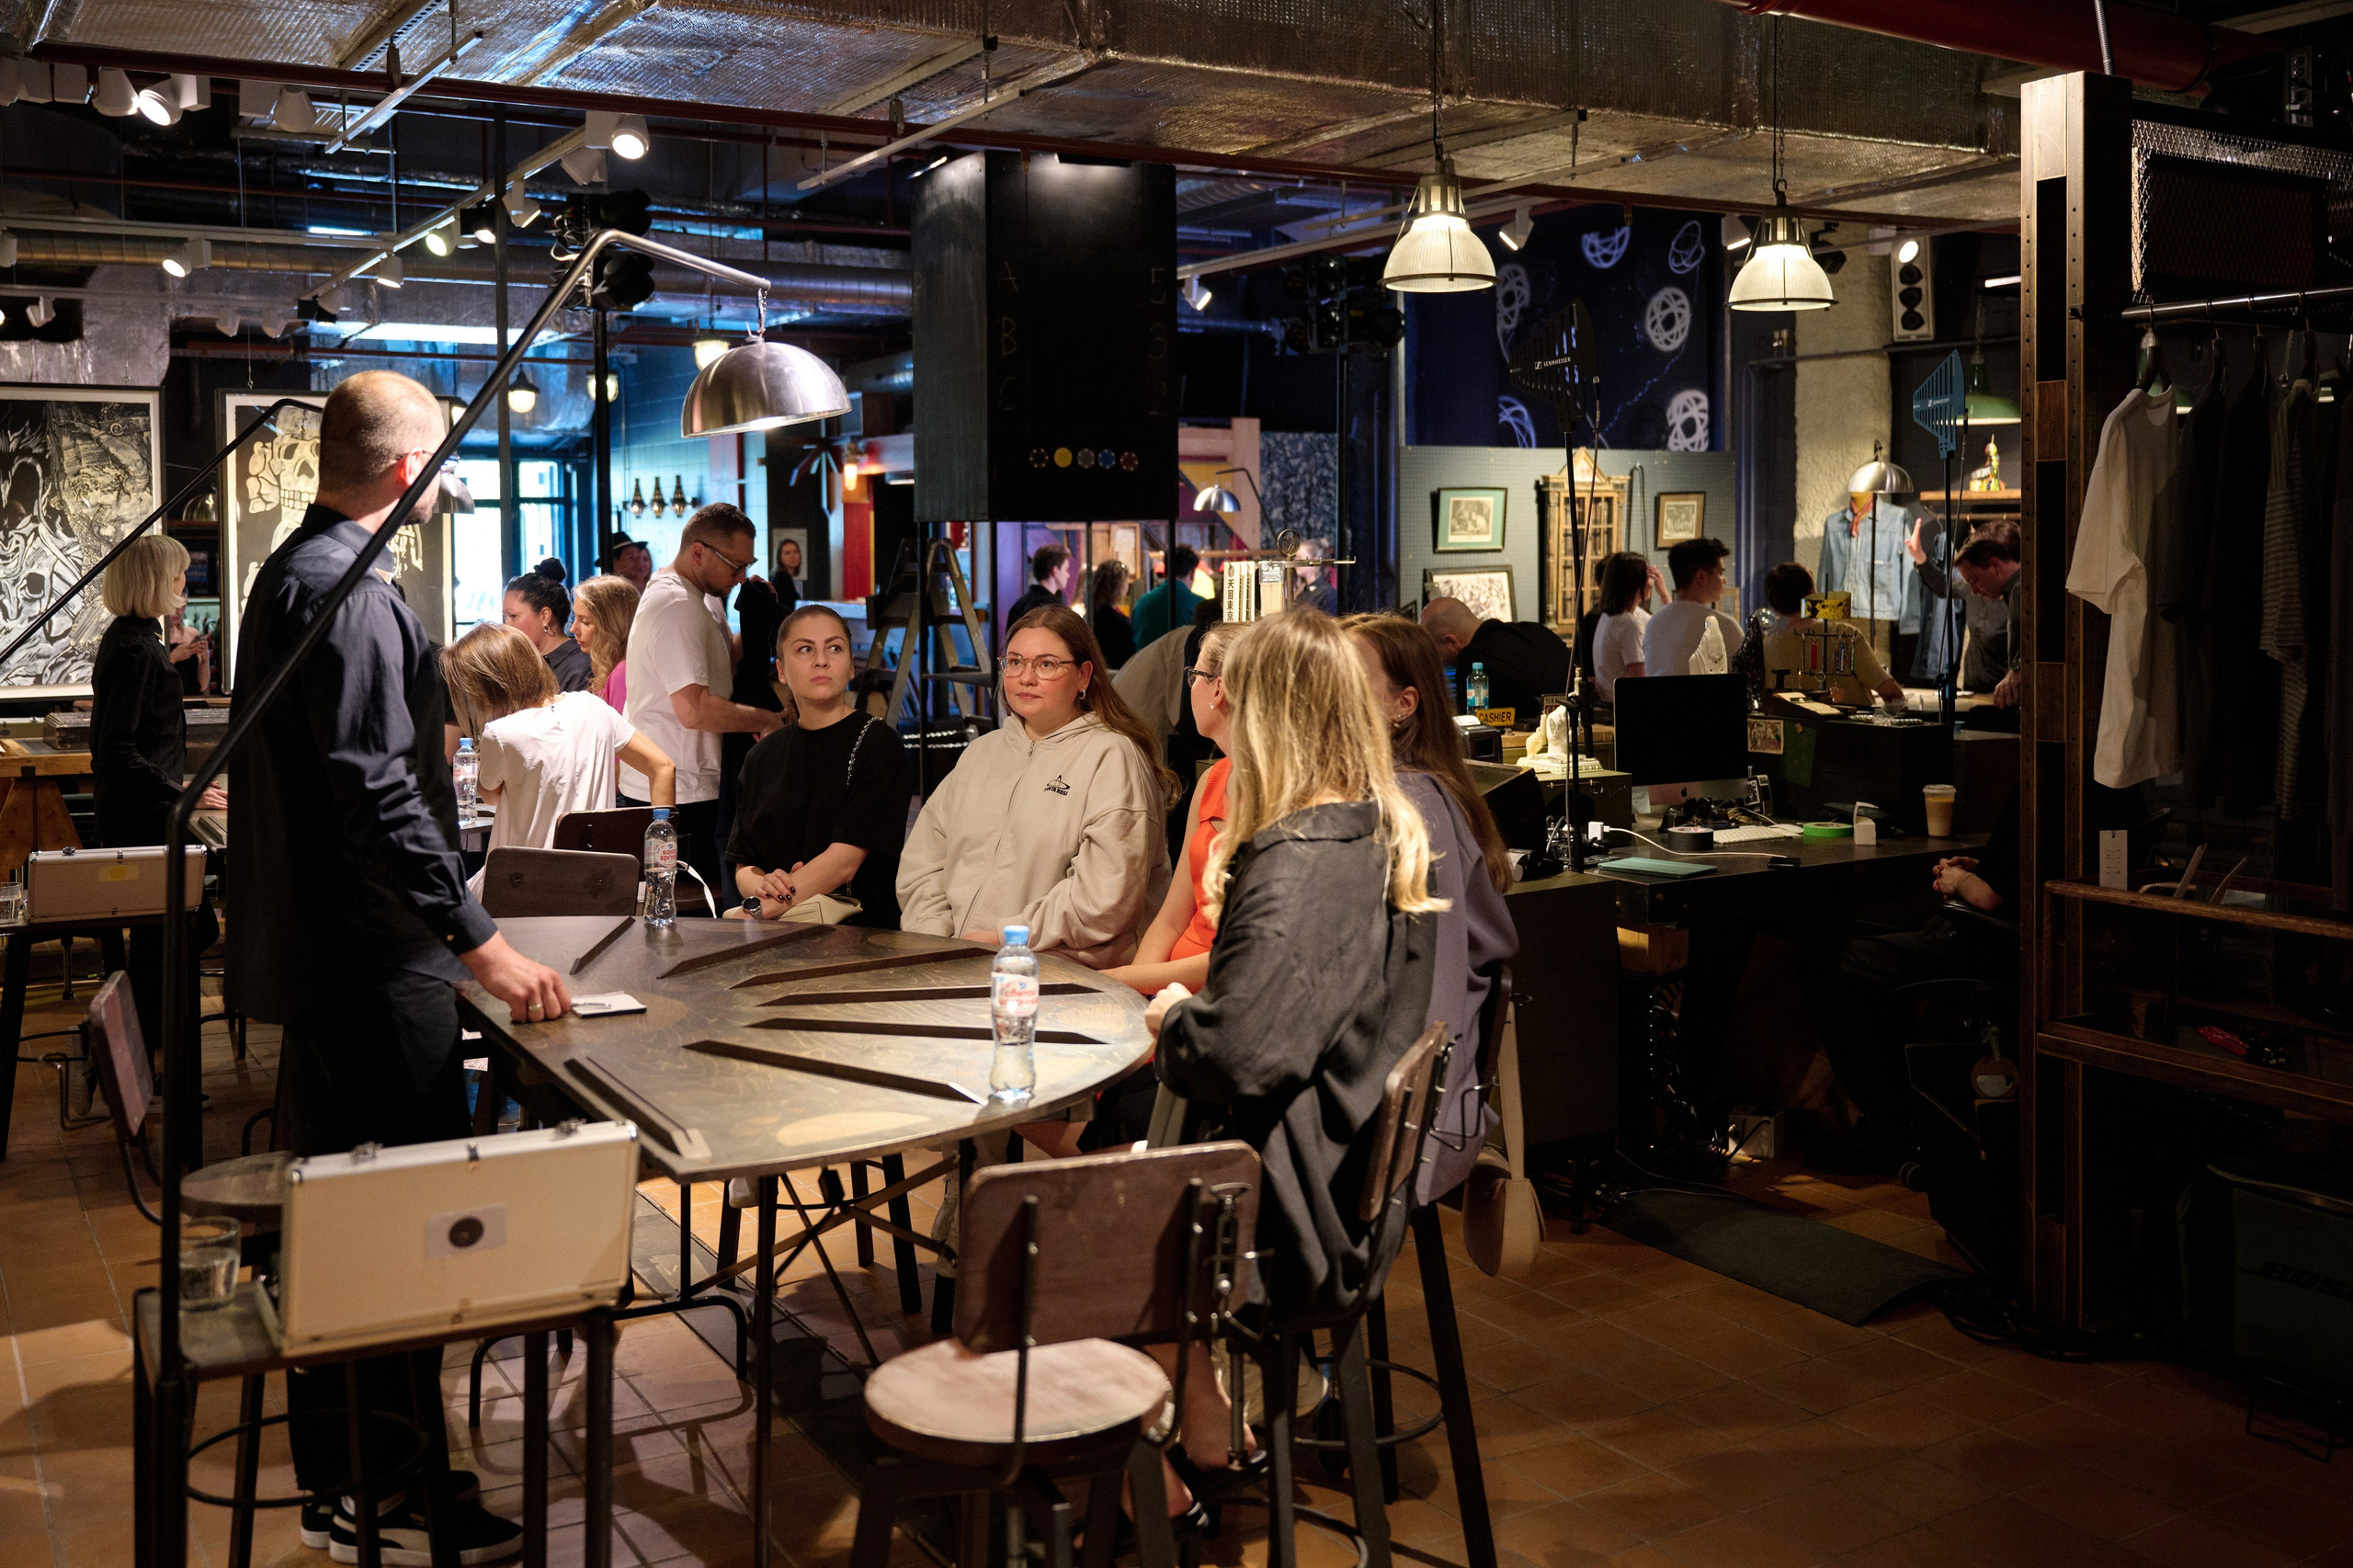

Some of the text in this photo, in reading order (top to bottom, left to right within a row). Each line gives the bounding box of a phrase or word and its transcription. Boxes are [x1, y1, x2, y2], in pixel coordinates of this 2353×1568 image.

[995, 261, 1167, 304] A 5
[1001, 316, 1167, 360] B 3
[1543, 356, 1572, 368] SENNHEISER
[999, 375, 1017, 412] C
[1479, 711, 1512, 723] CASHIER
[2243, 1260, 2353, 1303] BOS
